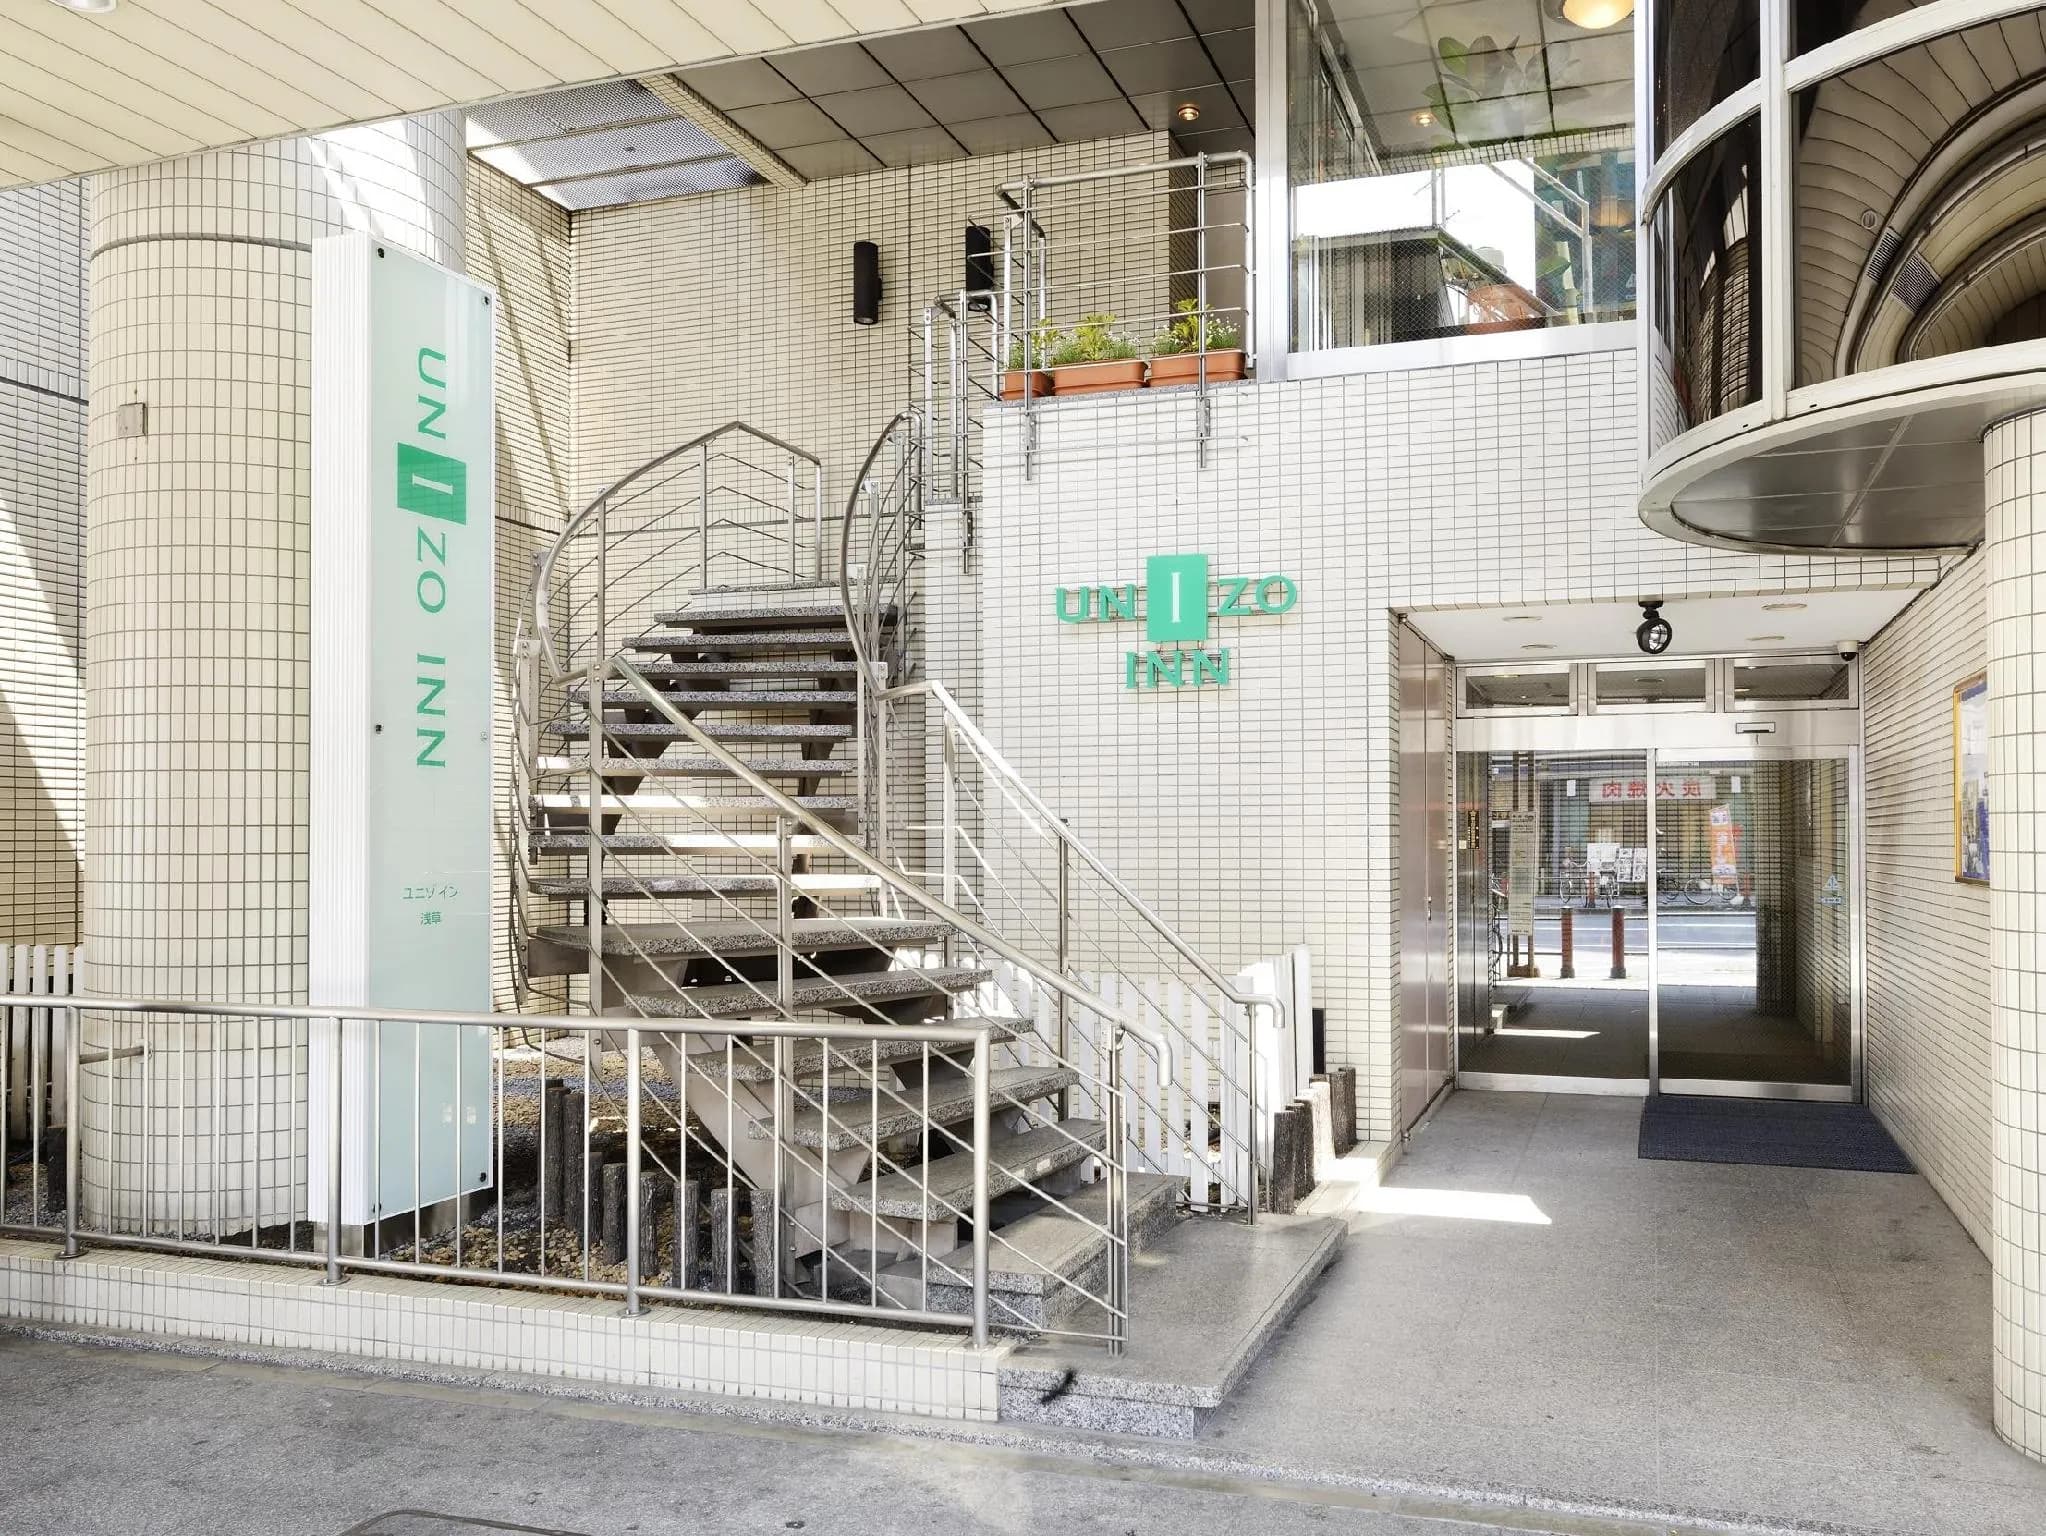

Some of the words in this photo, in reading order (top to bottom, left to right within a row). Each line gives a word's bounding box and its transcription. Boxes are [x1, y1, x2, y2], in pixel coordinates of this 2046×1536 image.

[411, 346, 454, 615] UNIZO
[1056, 571, 1298, 624] UNIZO
[1126, 648, 1230, 690] INN
[416, 653, 446, 768] INN
[420, 911, 442, 925] 浅草
